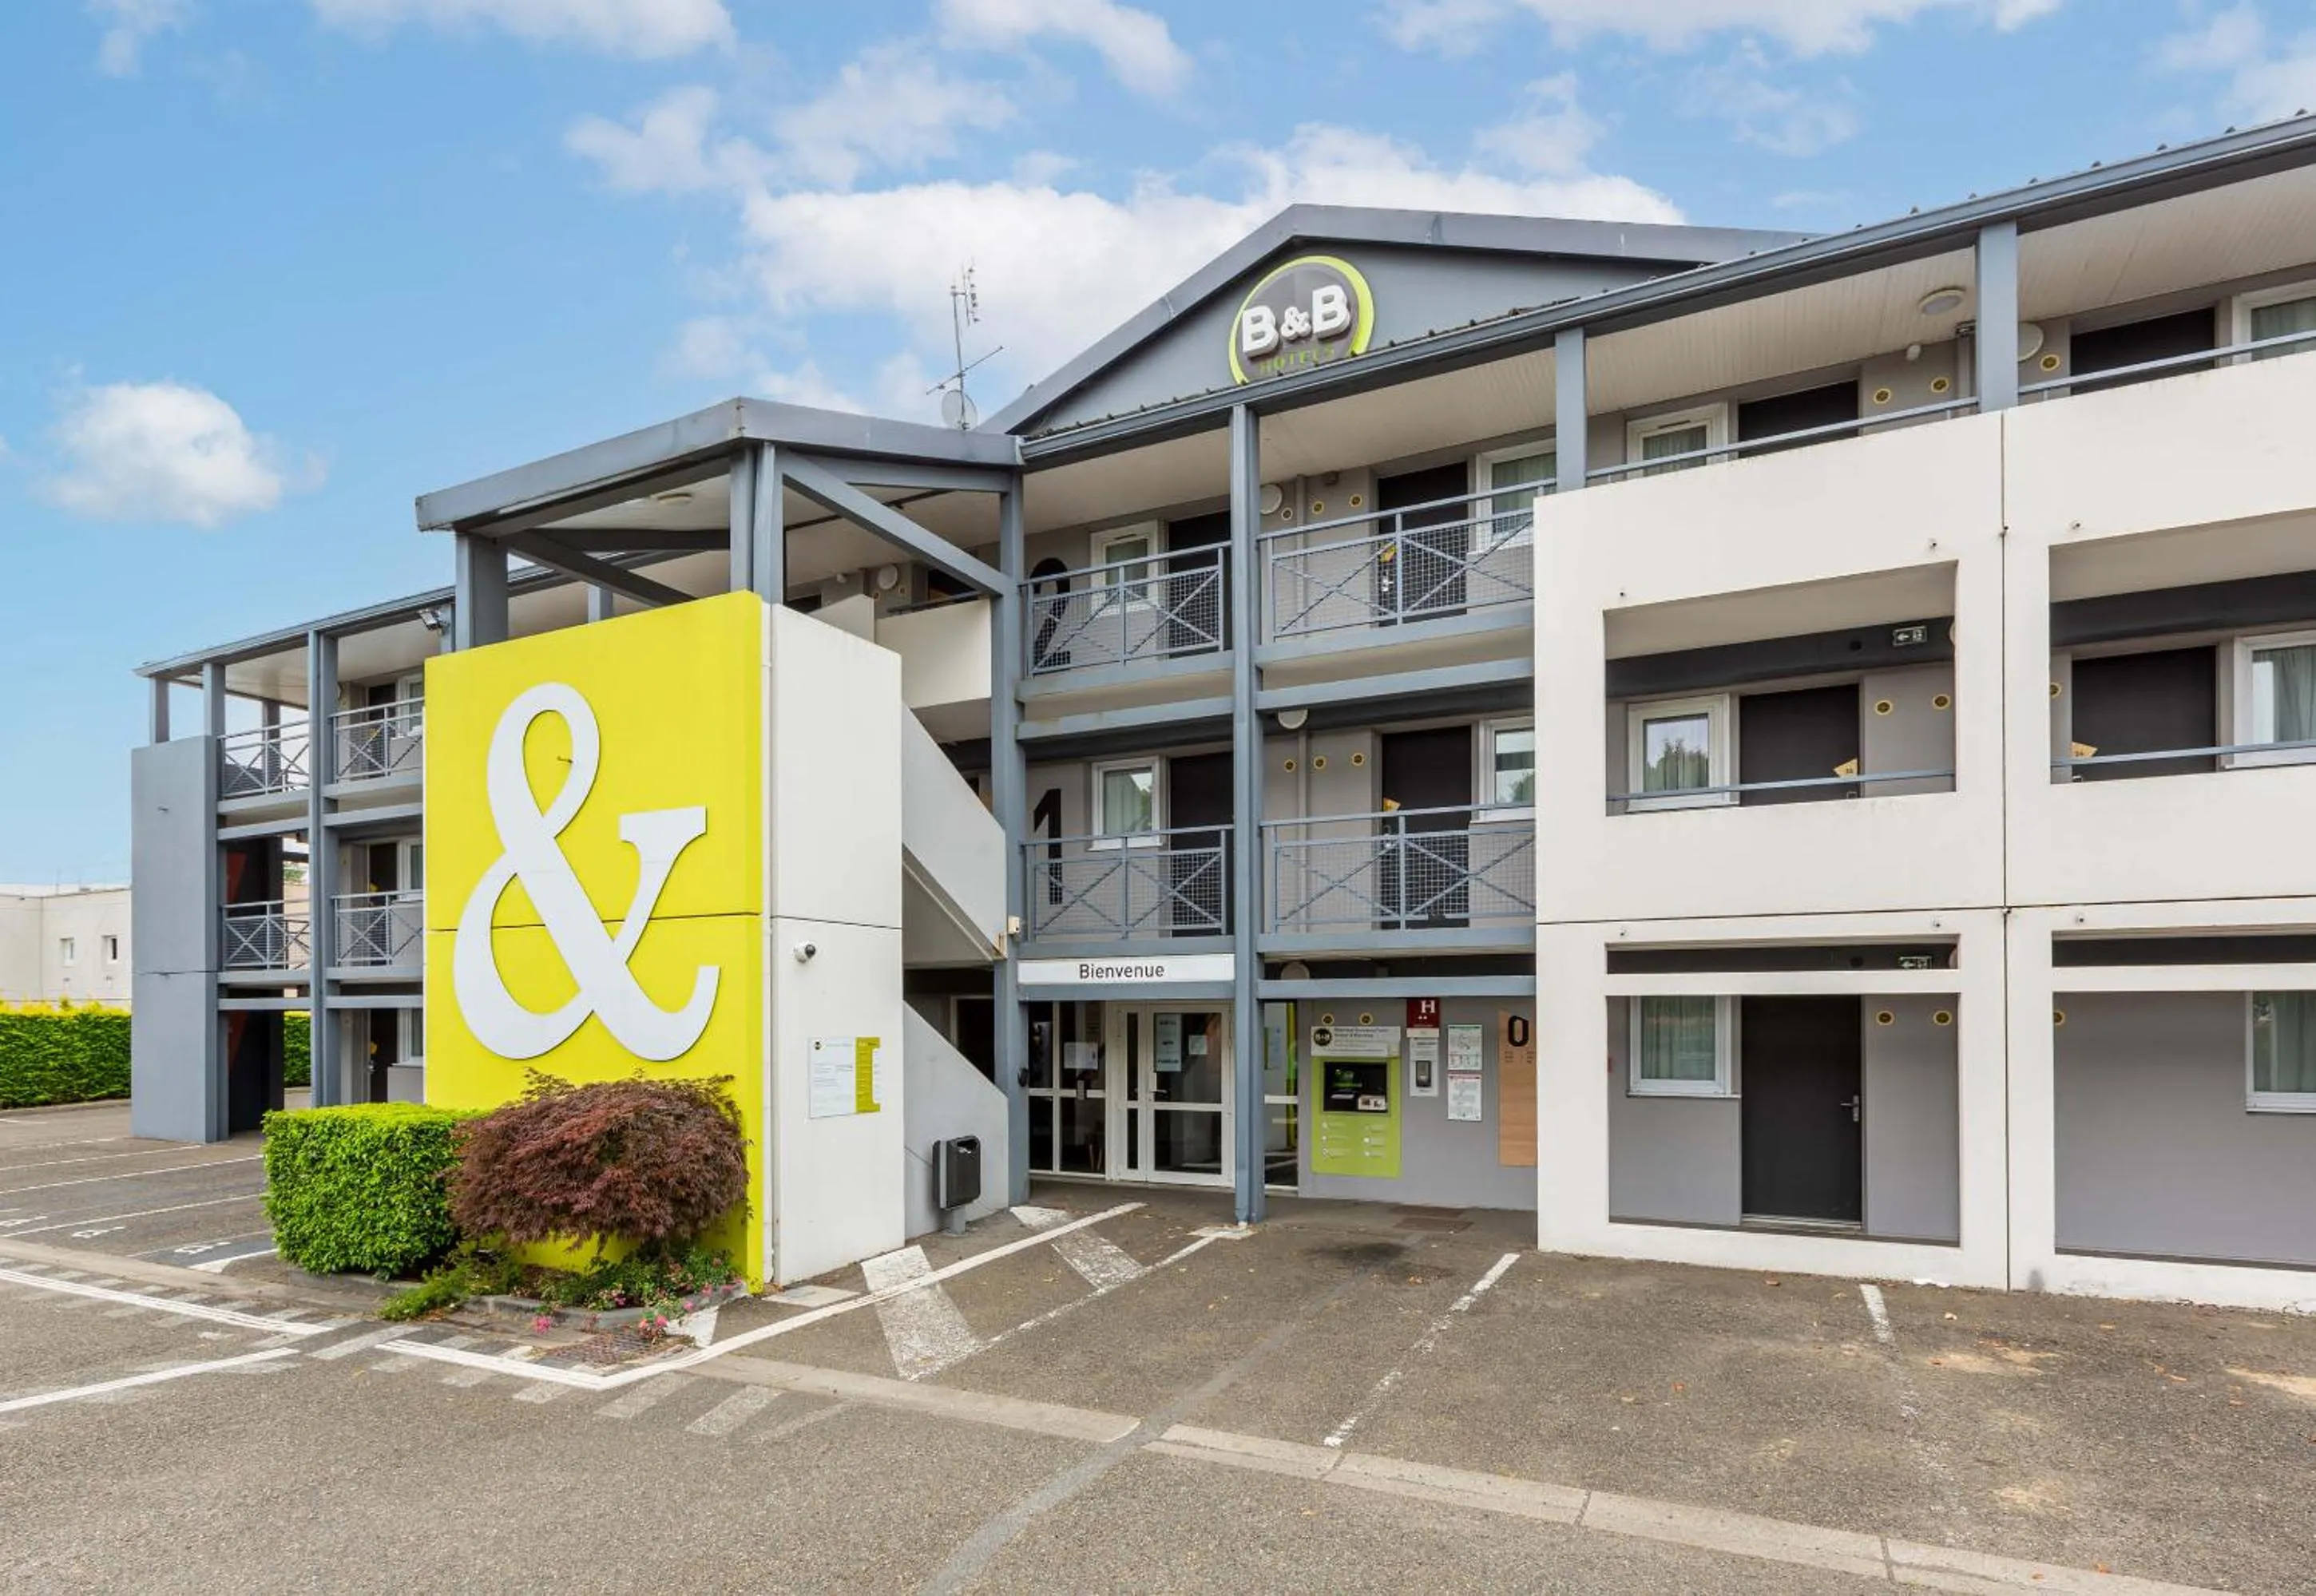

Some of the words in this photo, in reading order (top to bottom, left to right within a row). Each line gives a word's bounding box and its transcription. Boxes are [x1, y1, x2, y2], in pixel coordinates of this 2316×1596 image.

[1242, 284, 1351, 358] B&B
[1258, 344, 1336, 374] HOTELS
[453, 682, 721, 1063] &
[1033, 787, 1063, 906] 1
[1079, 964, 1165, 980] Bienvenue
[1421, 1000, 1436, 1013] H
